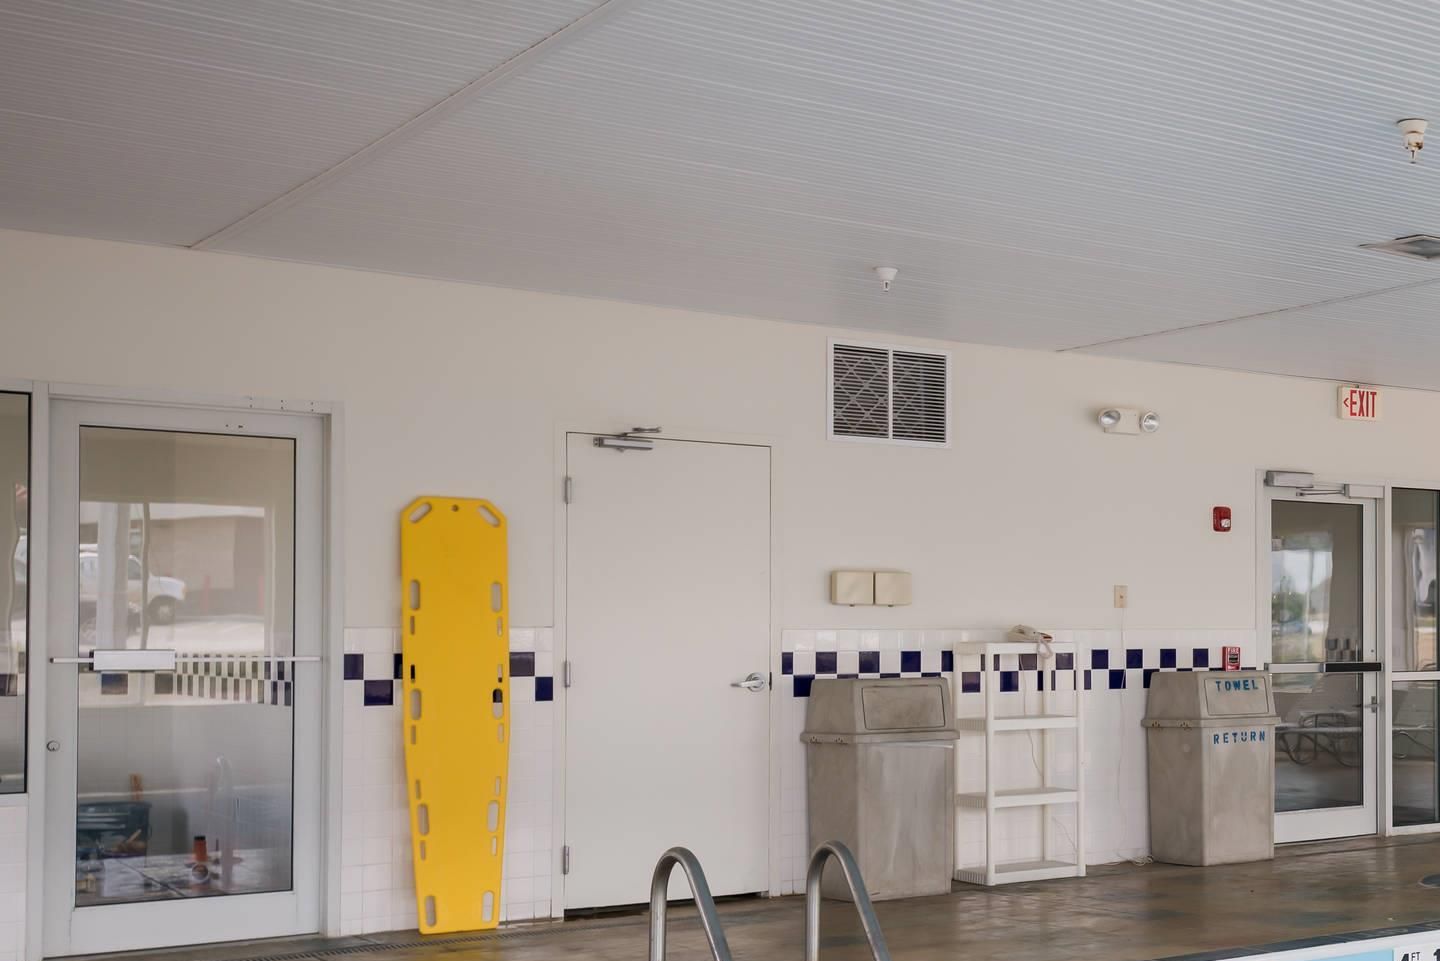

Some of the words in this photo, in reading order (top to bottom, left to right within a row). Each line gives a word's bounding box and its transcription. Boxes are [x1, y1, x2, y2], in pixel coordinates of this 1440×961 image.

[1349, 389, 1377, 418] EXIT
[1215, 679, 1259, 692] TOWEL
[1213, 730, 1266, 745] RETURN
